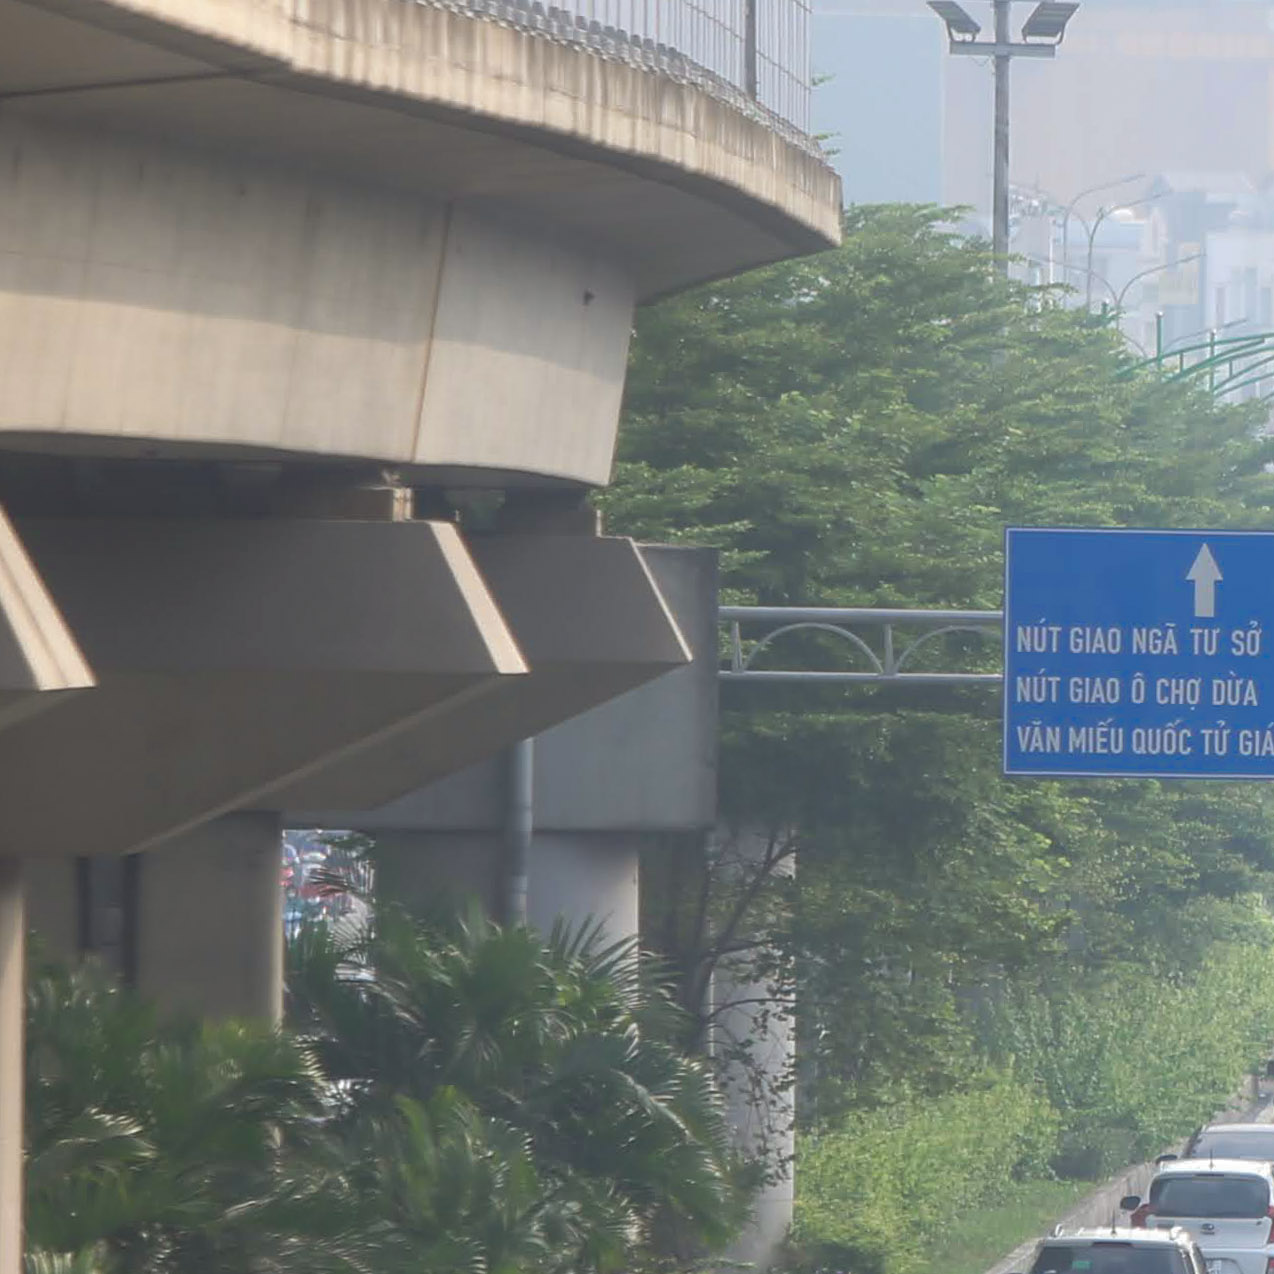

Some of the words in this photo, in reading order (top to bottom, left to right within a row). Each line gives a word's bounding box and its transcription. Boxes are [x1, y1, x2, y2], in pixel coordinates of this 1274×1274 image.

[1017, 618, 1062, 653] NÚT
[1070, 627, 1121, 654] GIAO
[1132, 623, 1178, 655] NGÃ
[1190, 628, 1220, 656] TƯ
[1231, 621, 1262, 656] SỞ
[1017, 668, 1061, 703] NÚT
[1070, 677, 1120, 704] GIAO
[1131, 672, 1145, 704] Ô
[1156, 678, 1201, 710] CHỢ
[1212, 671, 1258, 706] DỪA
[1017, 721, 1060, 752] VĂN
[1068, 718, 1123, 754] MIẾU
[1132, 719, 1192, 755] QUỐC
[1201, 720, 1230, 755] TỬ
